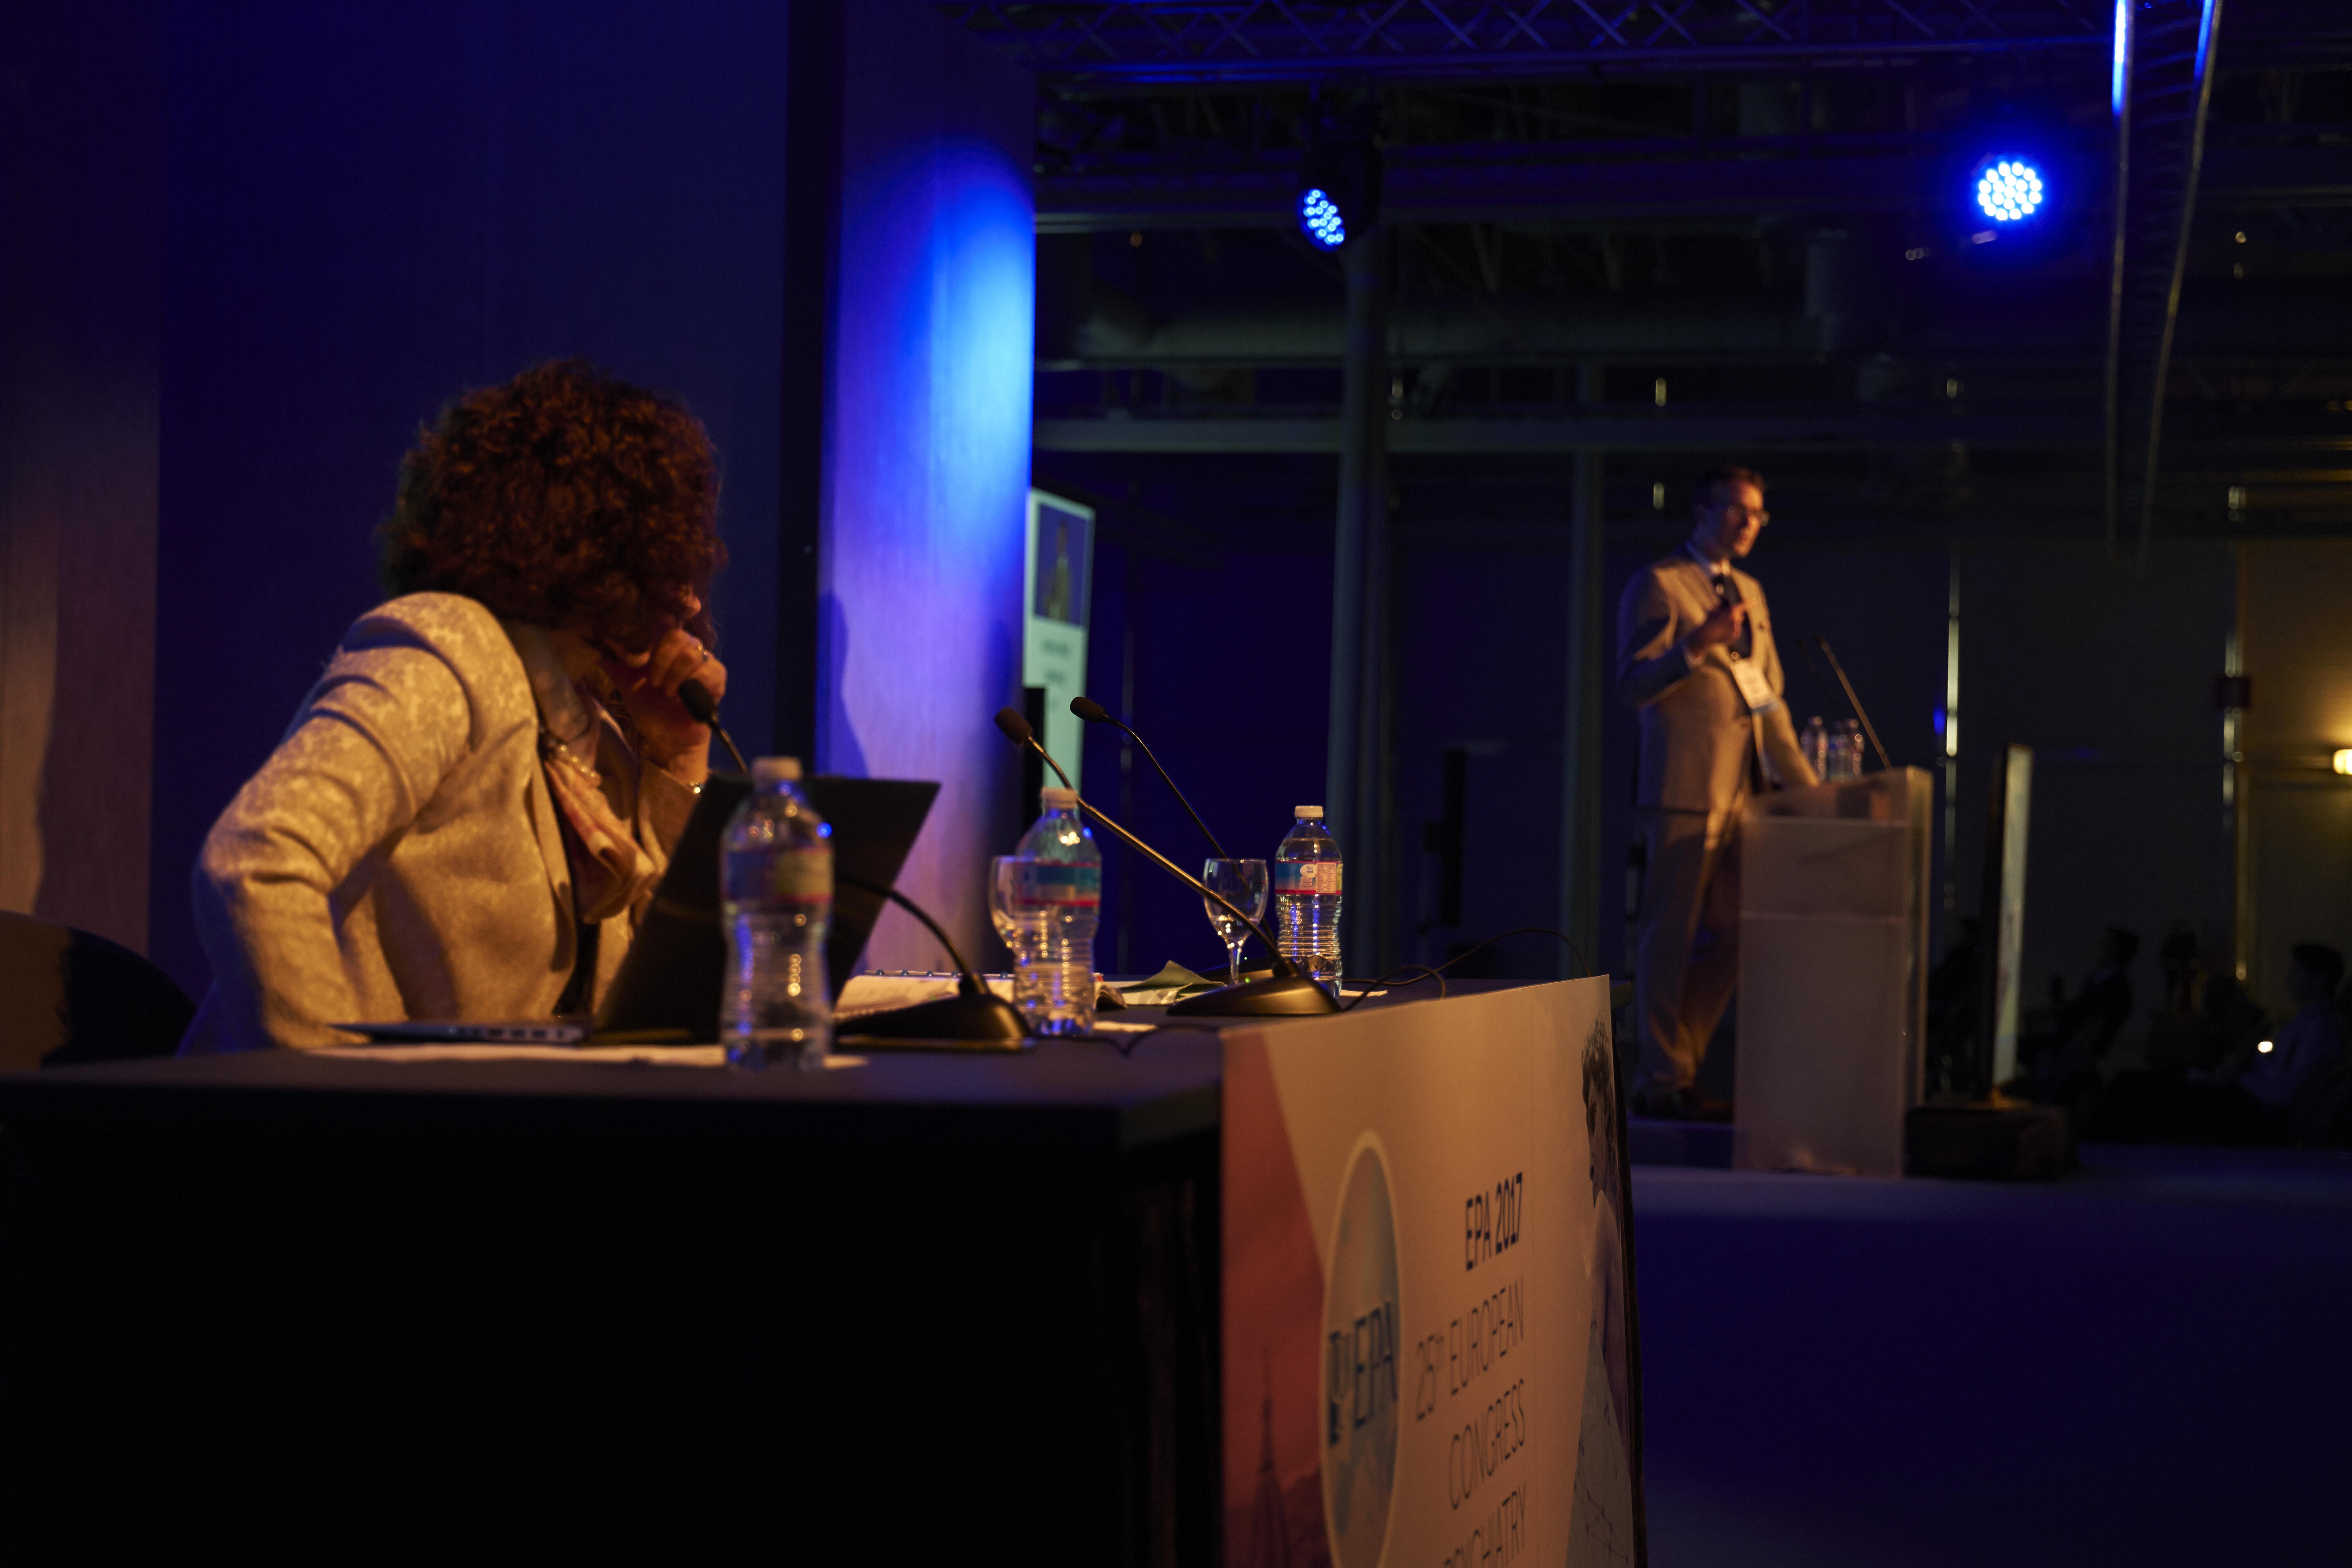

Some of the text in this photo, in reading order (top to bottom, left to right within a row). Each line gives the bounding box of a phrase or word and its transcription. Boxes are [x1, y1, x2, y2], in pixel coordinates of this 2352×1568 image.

[1466, 1172, 1523, 1271] EPA 2017
[1354, 1301, 1399, 1431] EPA
[1451, 1276, 1523, 1396] EUROPEAN
[1450, 1377, 1525, 1510] CONGRESS
